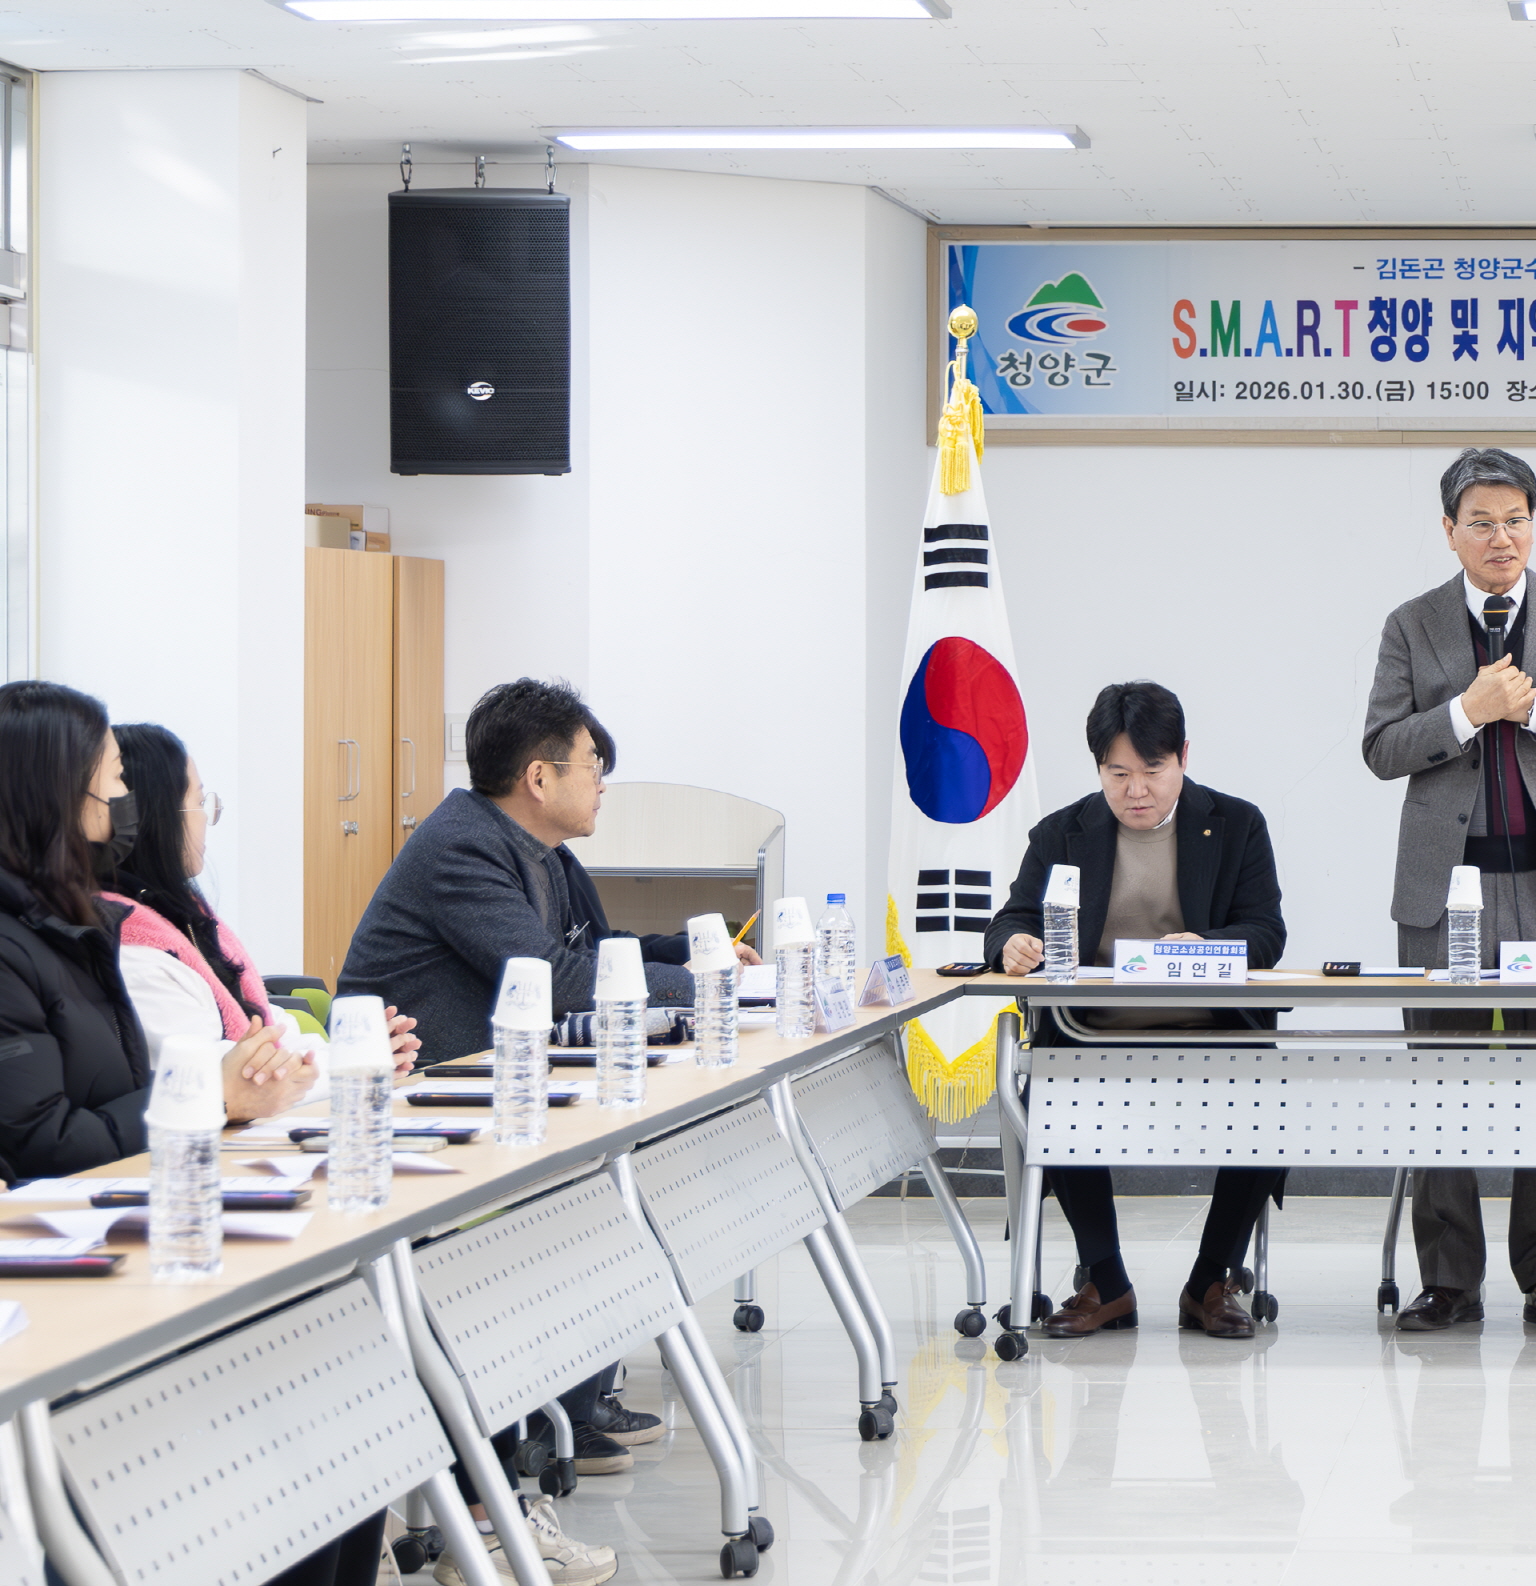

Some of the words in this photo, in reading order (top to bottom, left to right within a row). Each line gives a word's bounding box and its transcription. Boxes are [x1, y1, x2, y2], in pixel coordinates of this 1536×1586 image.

[1376, 257, 1446, 281] 김돈곤
[1172, 298, 1359, 359] S.M.A.R.T
[1367, 297, 1433, 363] 청양
[1450, 297, 1479, 362] 및
[999, 351, 1117, 386] 청양군
[1173, 380, 1225, 402] 일시:
[1235, 379, 1415, 402] 2026.01.30.(금)
[1426, 380, 1490, 400] 15:00
